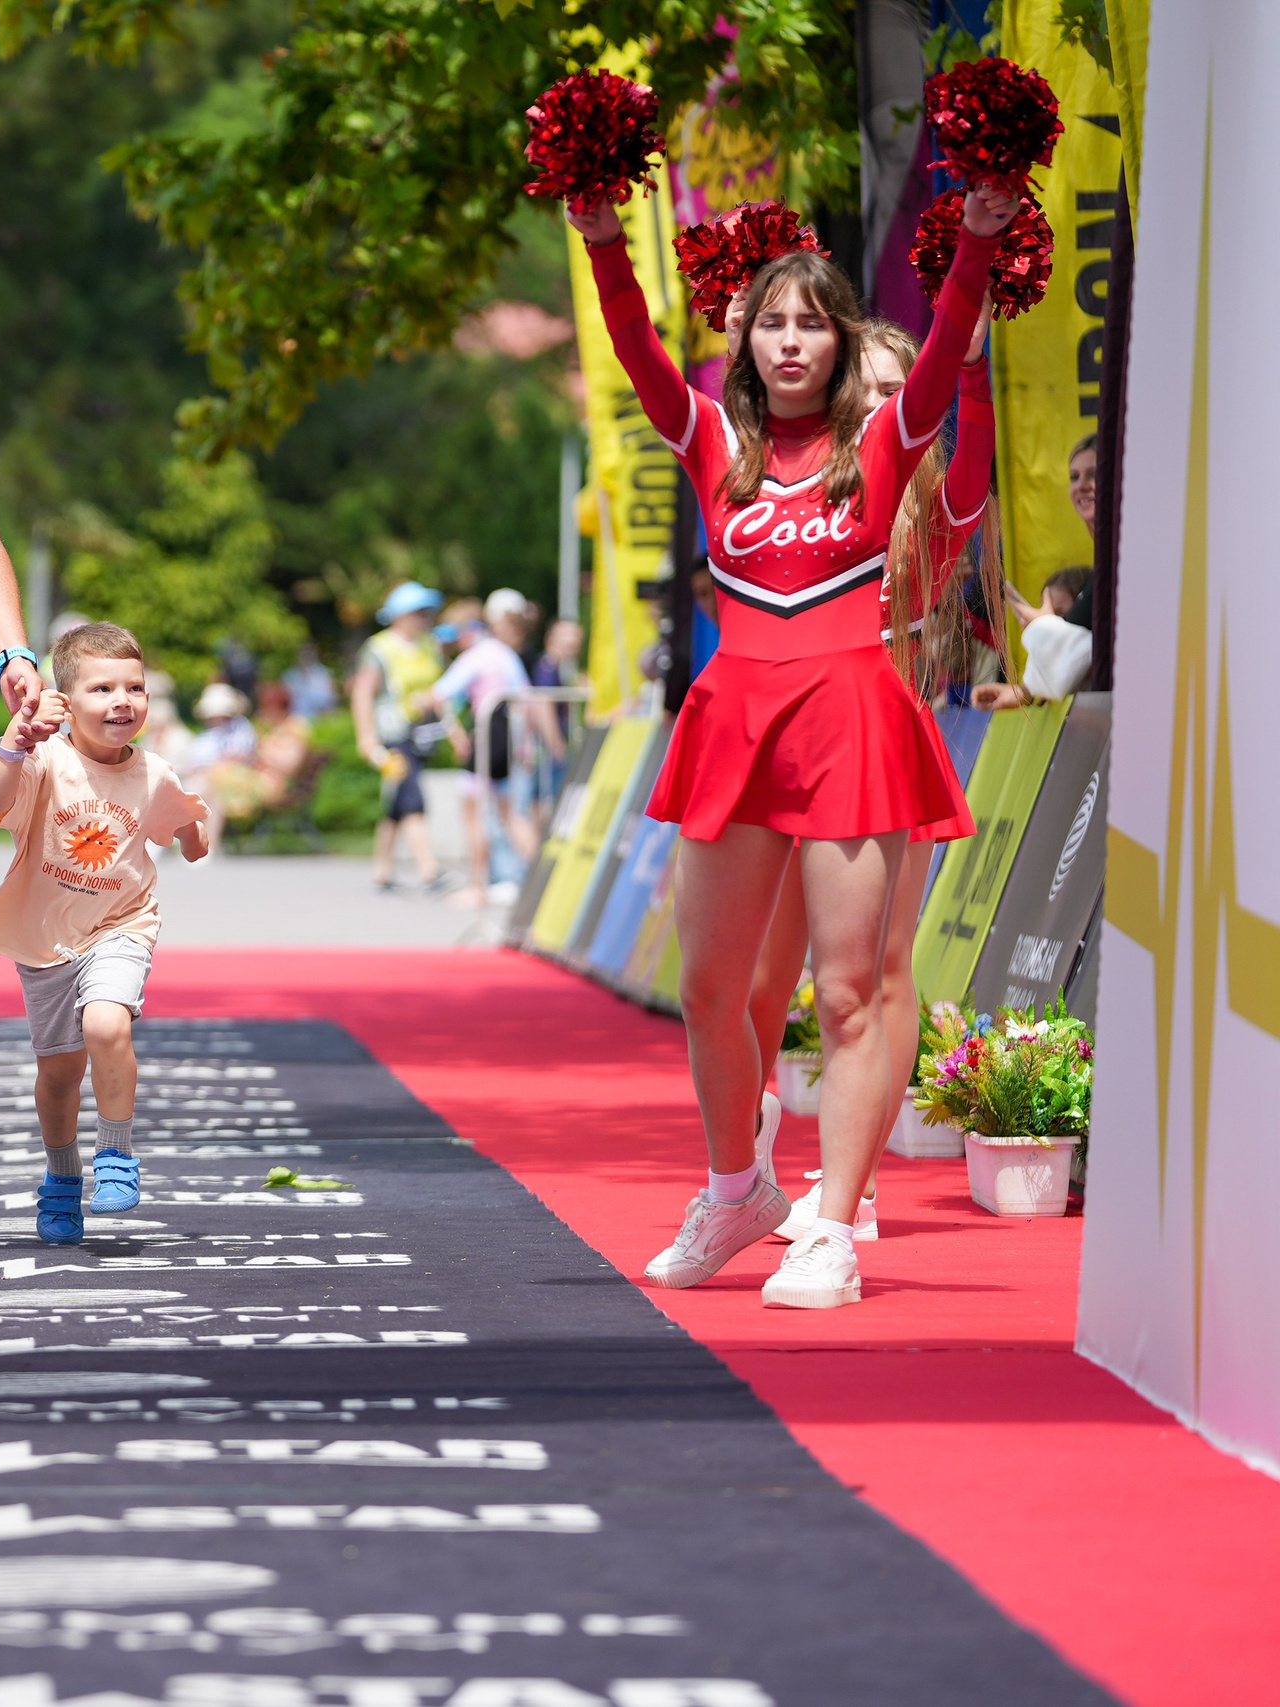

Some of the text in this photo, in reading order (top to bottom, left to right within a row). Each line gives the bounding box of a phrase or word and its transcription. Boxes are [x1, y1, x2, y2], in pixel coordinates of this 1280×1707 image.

[723, 496, 852, 556] Cool
[53, 800, 139, 837] ENJOY THE SWEETNESS
[42, 862, 123, 890] OF DOING NOTHING
[97, 1253, 411, 1267] STAR
[108, 1330, 469, 1346] STAR
[116, 1438, 549, 1462] STAR
[123, 1503, 601, 1529] STAR
[165, 1672, 772, 1707] STAR
